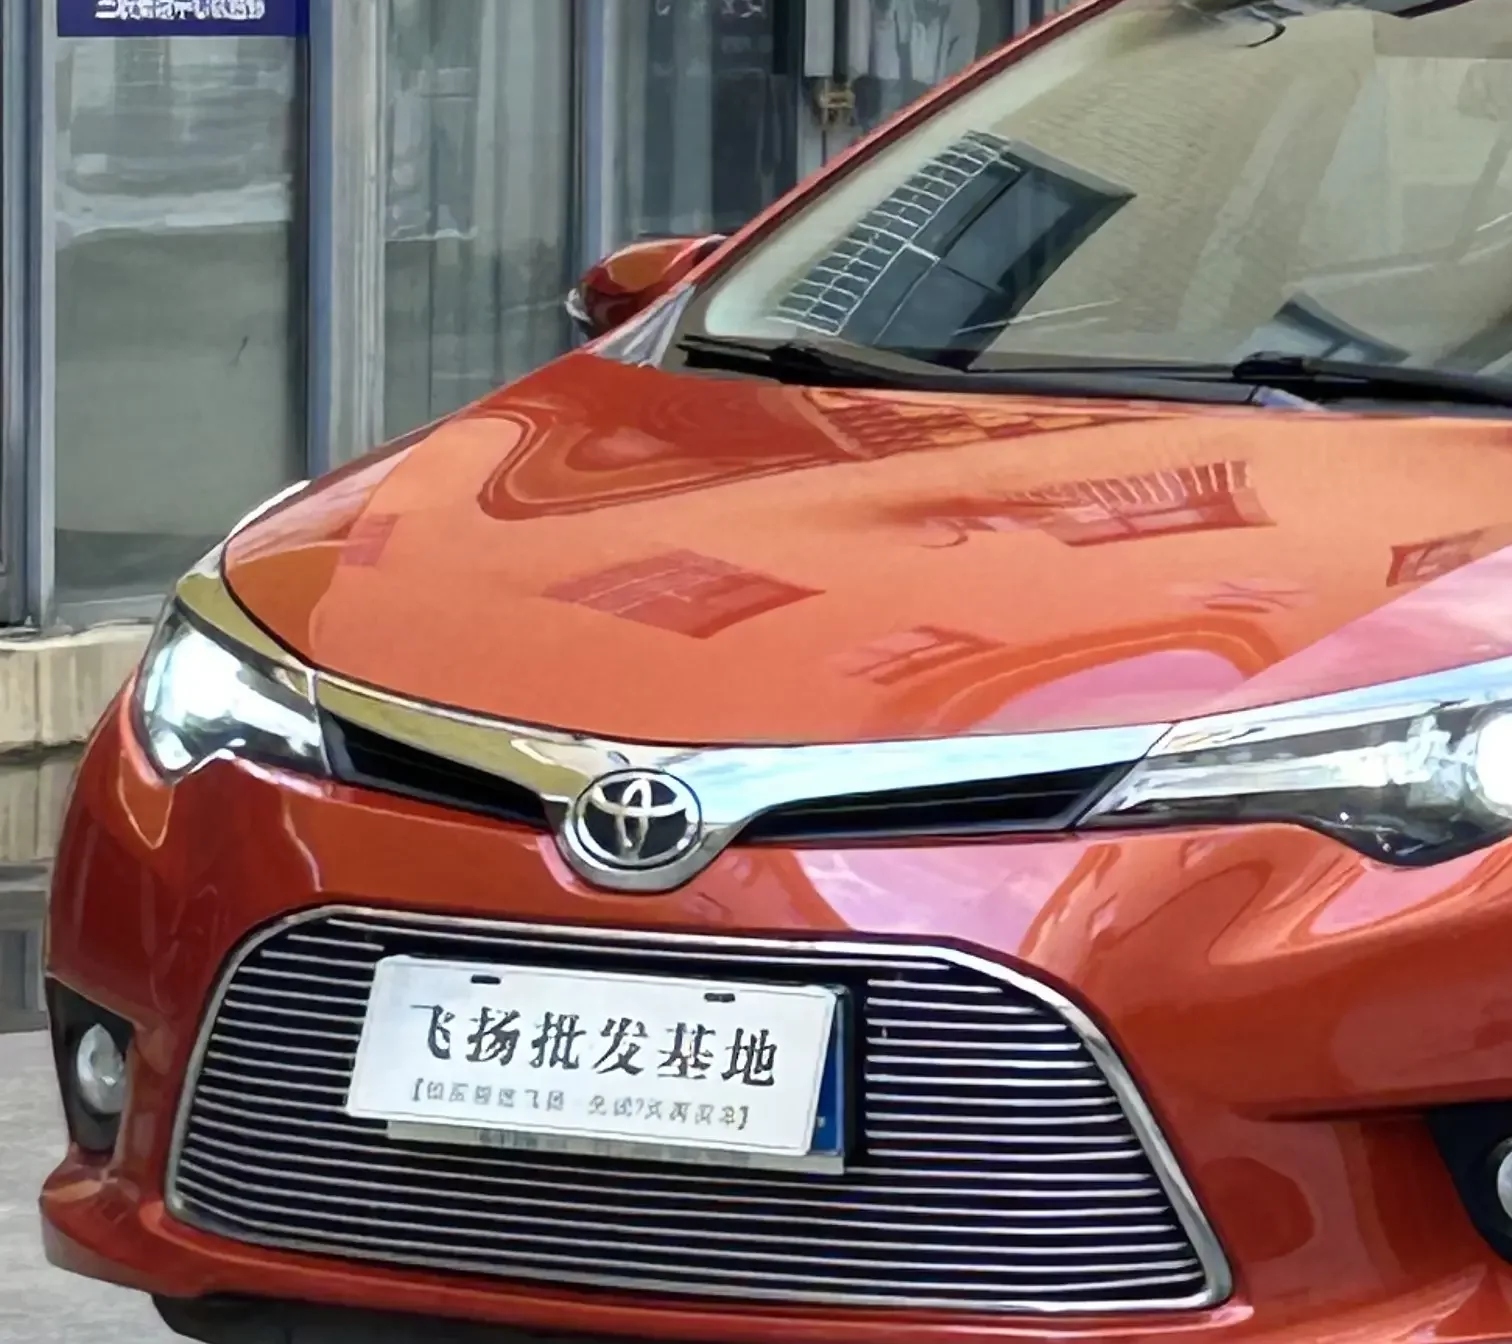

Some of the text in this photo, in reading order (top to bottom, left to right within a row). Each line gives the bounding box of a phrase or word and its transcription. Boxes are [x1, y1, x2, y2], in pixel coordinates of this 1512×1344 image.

[410, 1004, 779, 1087] 飞扬批发基地
